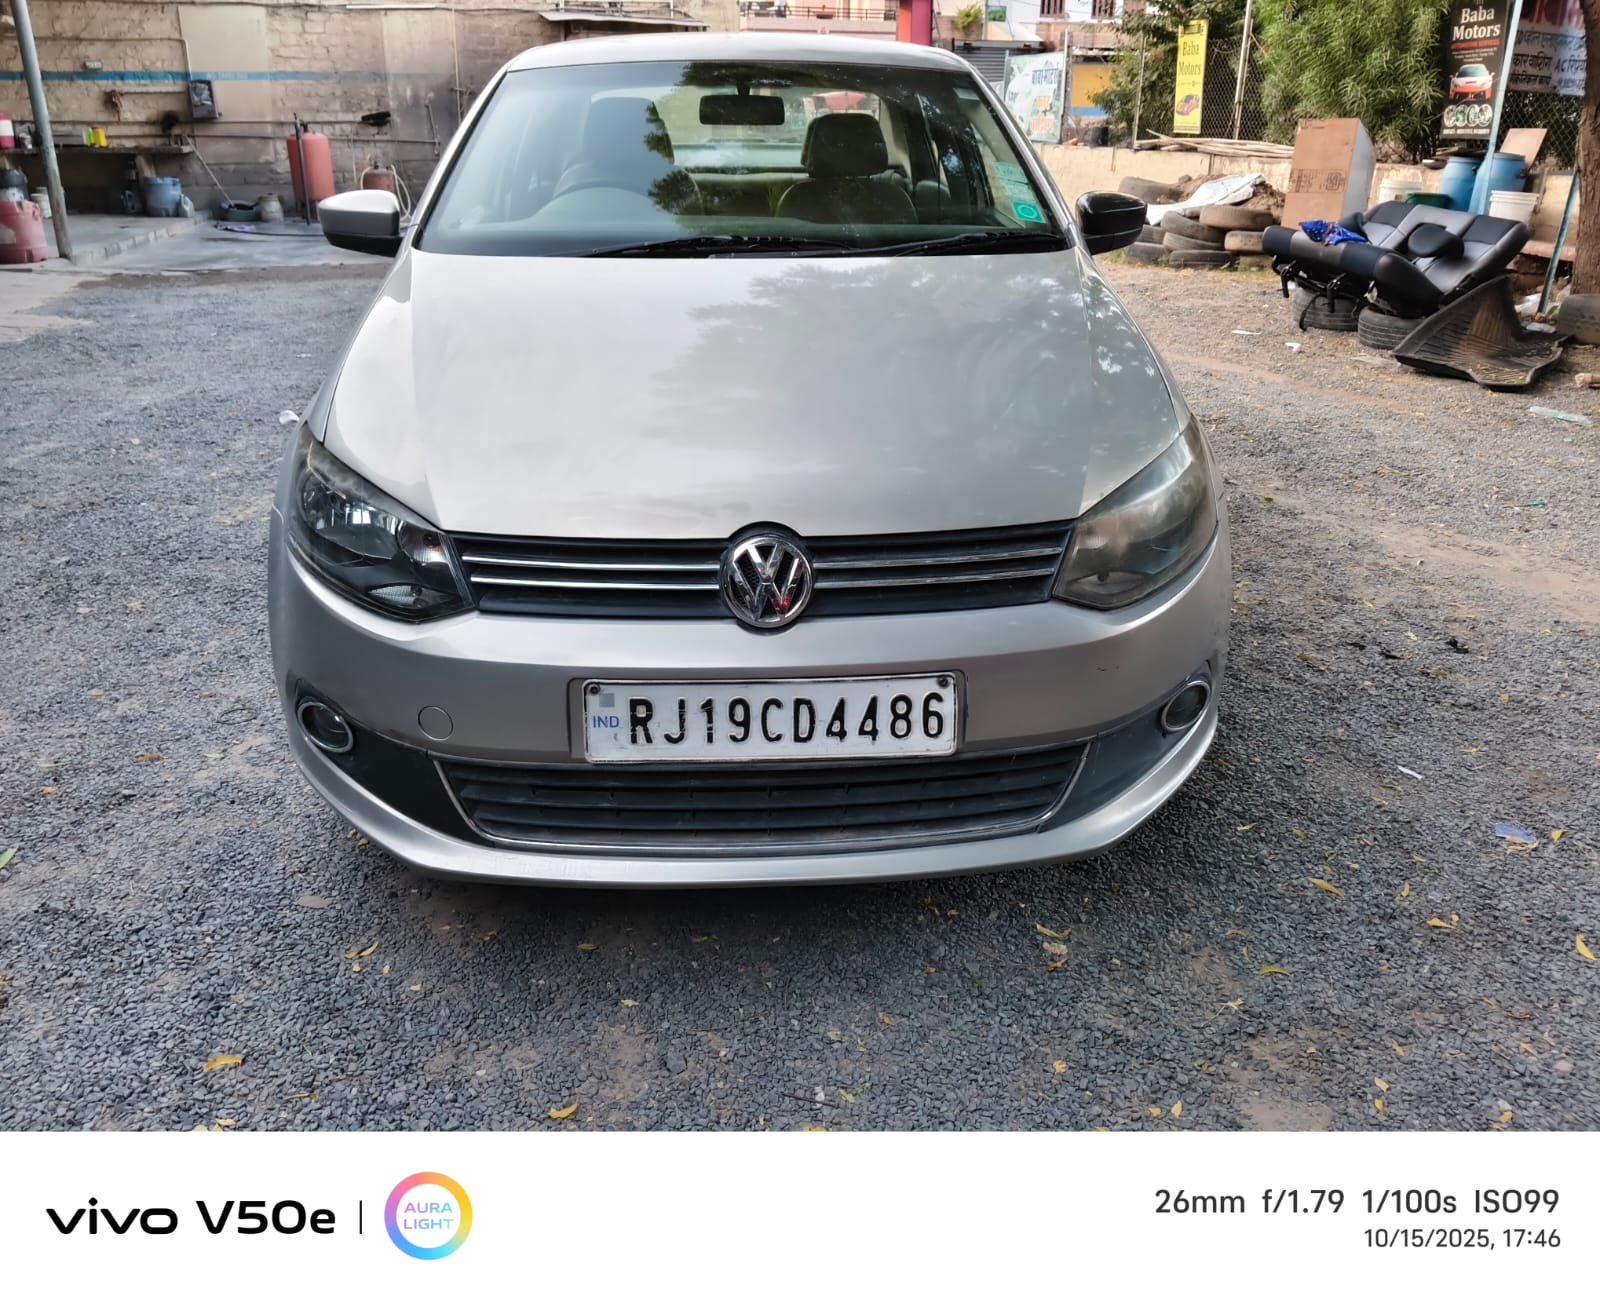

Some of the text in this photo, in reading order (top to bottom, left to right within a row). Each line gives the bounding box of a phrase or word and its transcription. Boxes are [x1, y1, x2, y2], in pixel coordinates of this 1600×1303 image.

[1461, 5, 1495, 23] Baba
[1452, 24, 1501, 41] Motors
[1182, 40, 1200, 56] Baba
[1178, 61, 1201, 76] Motors
[592, 715, 620, 729] IND
[628, 692, 944, 745] RJ19CD4486
